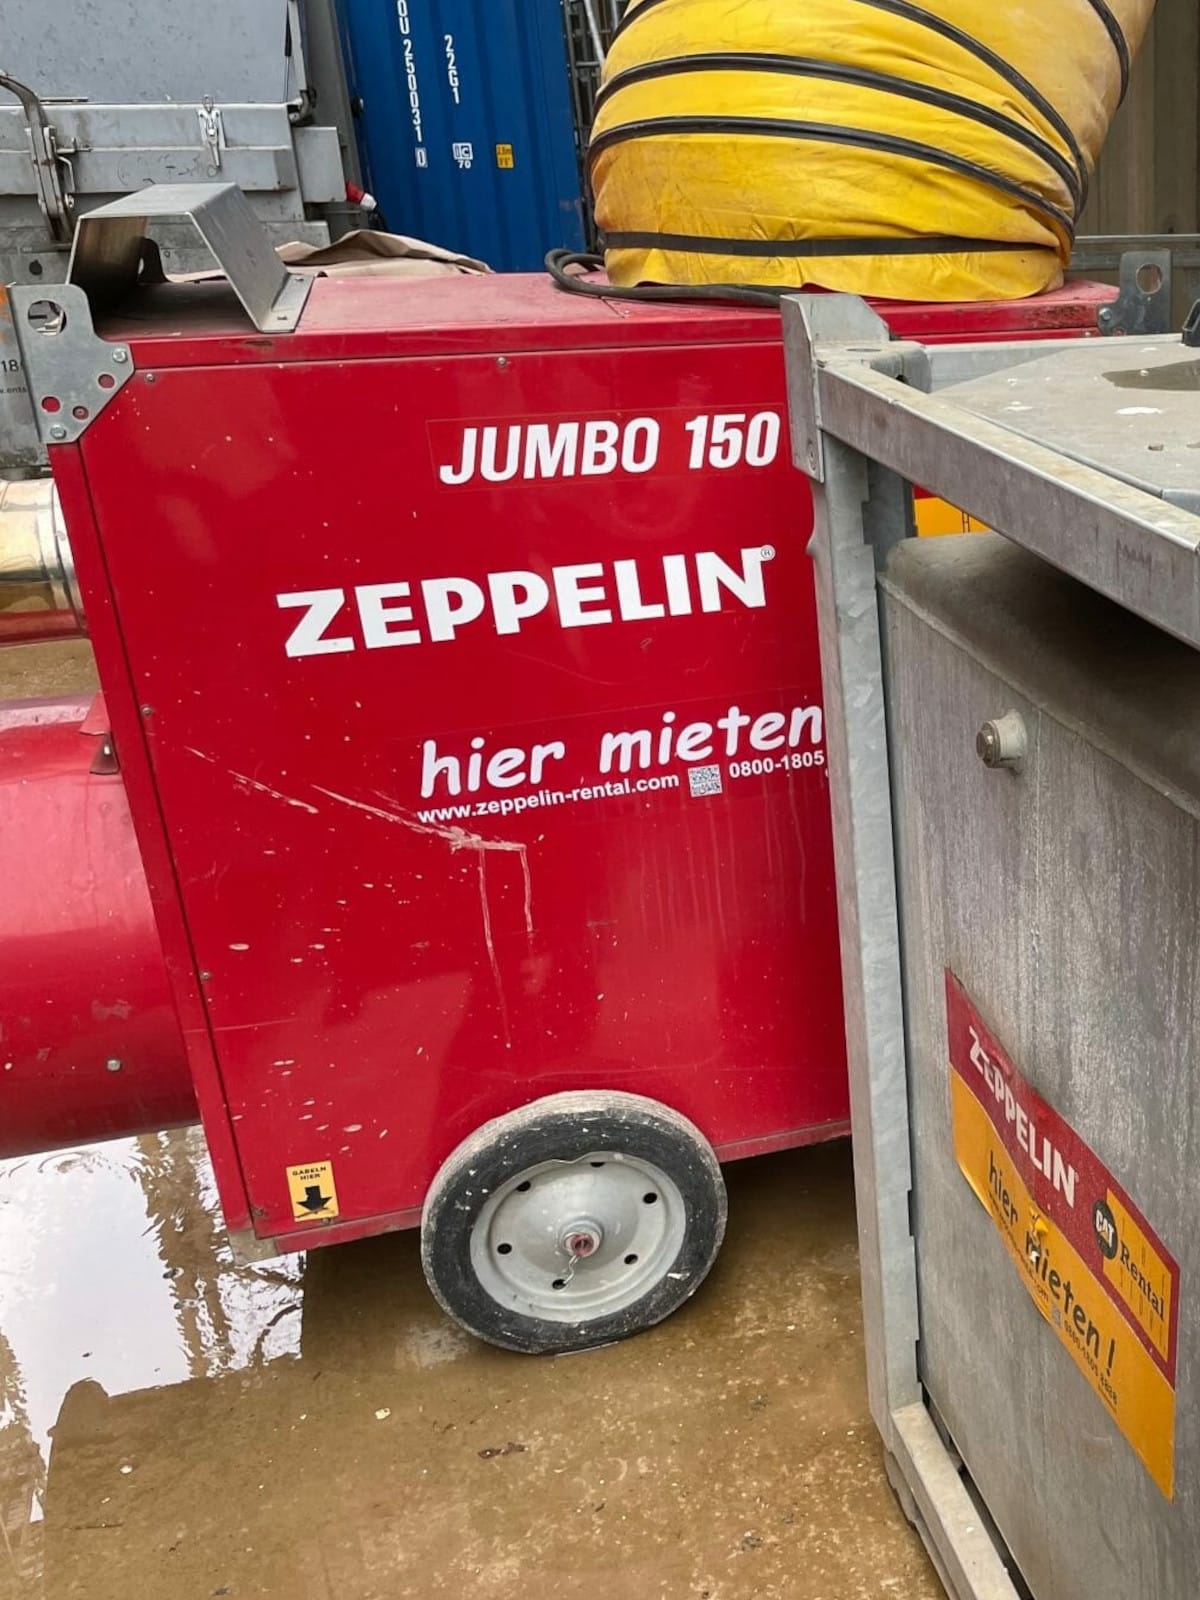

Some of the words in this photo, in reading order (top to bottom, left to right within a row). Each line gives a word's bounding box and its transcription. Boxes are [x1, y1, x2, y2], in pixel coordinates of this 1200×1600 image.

[403, 39, 422, 142] 250031
[444, 34, 460, 104] 22G1
[457, 160, 472, 169] 70
[439, 417, 660, 485] JUMBO
[684, 411, 781, 470] 150
[417, 771, 680, 824] www.zeppelin-rental.com
[728, 749, 826, 779] 0800-1805
[420, 736, 565, 799] hier
[599, 705, 823, 774] mieten
[989, 1150, 1018, 1227] hier
[1095, 1208, 1115, 1249] CAT
[1119, 1239, 1165, 1322] Rental
